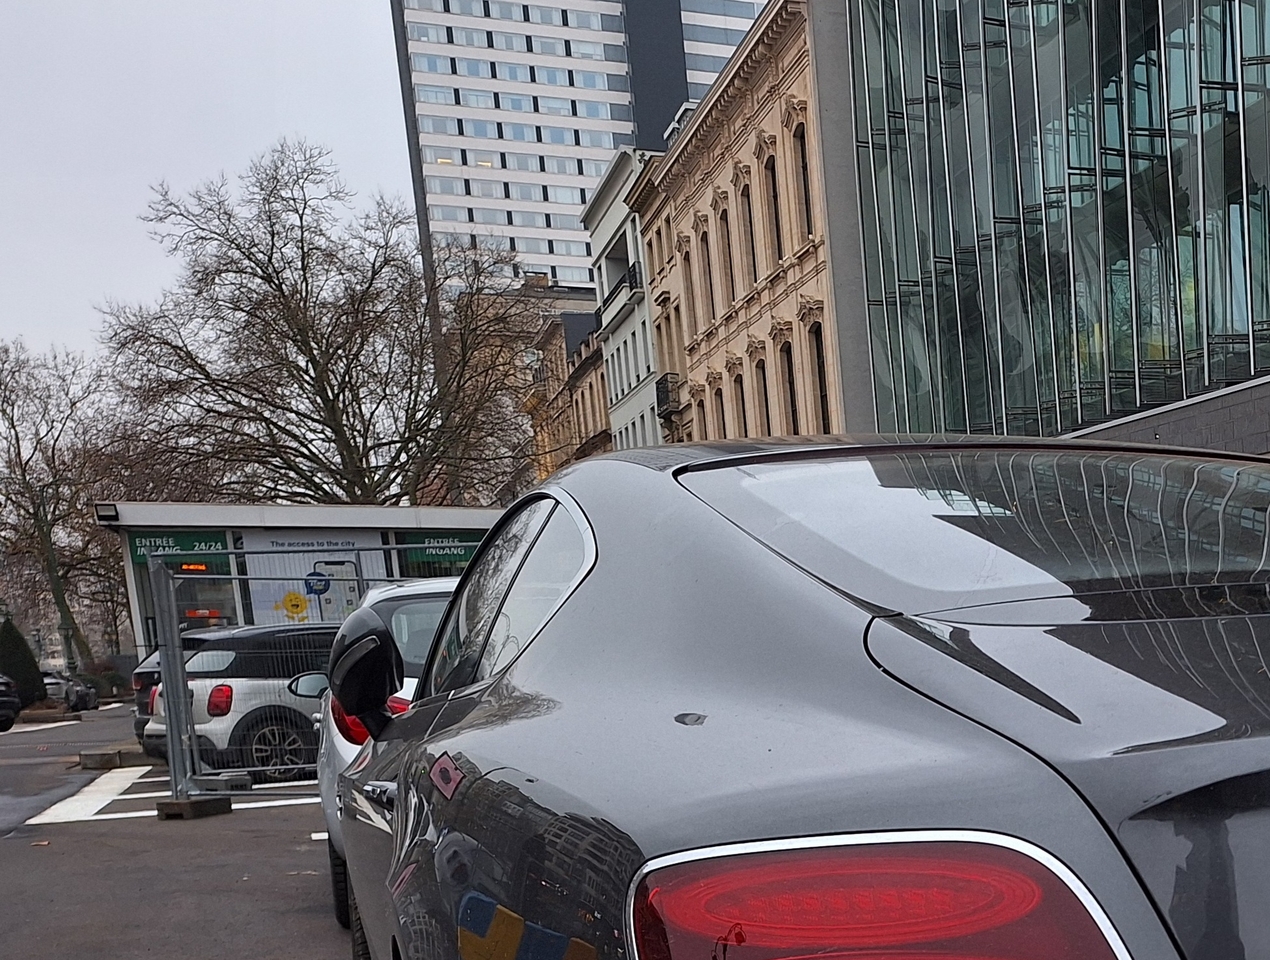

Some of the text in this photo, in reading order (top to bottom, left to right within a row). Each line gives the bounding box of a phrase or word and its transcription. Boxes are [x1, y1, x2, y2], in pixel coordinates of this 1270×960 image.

[135, 536, 175, 547] ENTRÉE
[193, 542, 222, 551] 24/24
[426, 547, 465, 555] INGANG
